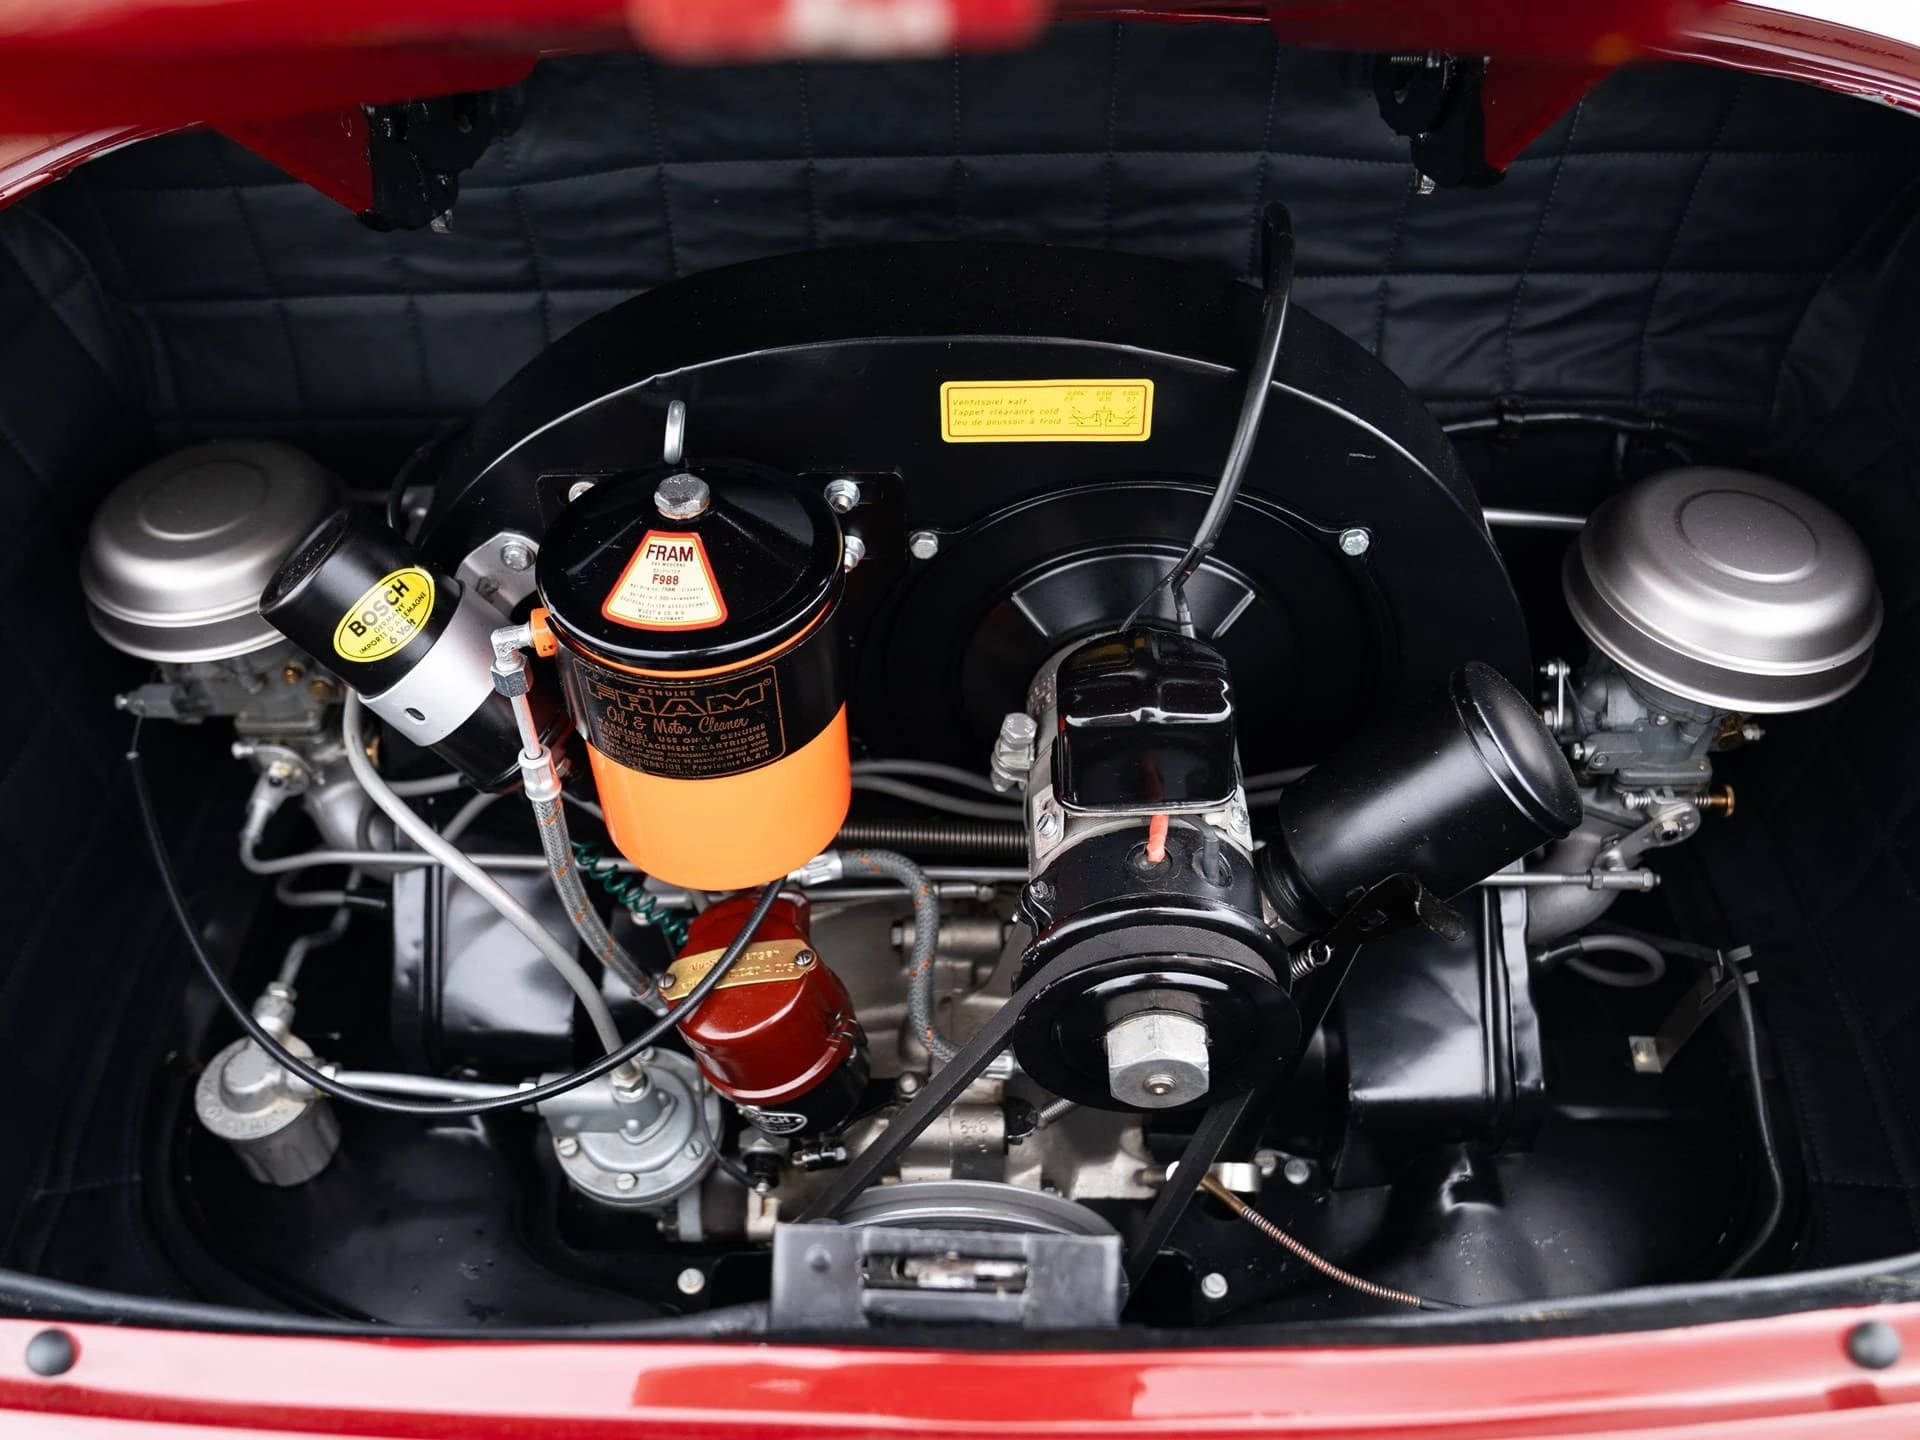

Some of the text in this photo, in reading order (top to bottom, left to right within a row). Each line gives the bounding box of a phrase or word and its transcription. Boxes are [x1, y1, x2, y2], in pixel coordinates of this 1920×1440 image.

[952, 407, 1061, 417] Tappet clearance cold
[646, 544, 693, 562] FRAM
[652, 574, 680, 585] F988
[348, 578, 410, 638] BOSCH
[374, 603, 405, 633] GERMANY
[389, 617, 417, 645] 6 Volt
[585, 675, 765, 717] FRAM
[637, 687, 696, 698] GENUINE
[606, 705, 750, 735] Oil & Motor Cleaner
[657, 736, 678, 744] USE
[719, 722, 767, 741] GENUINE
[701, 730, 769, 751] CARTRIDGES
